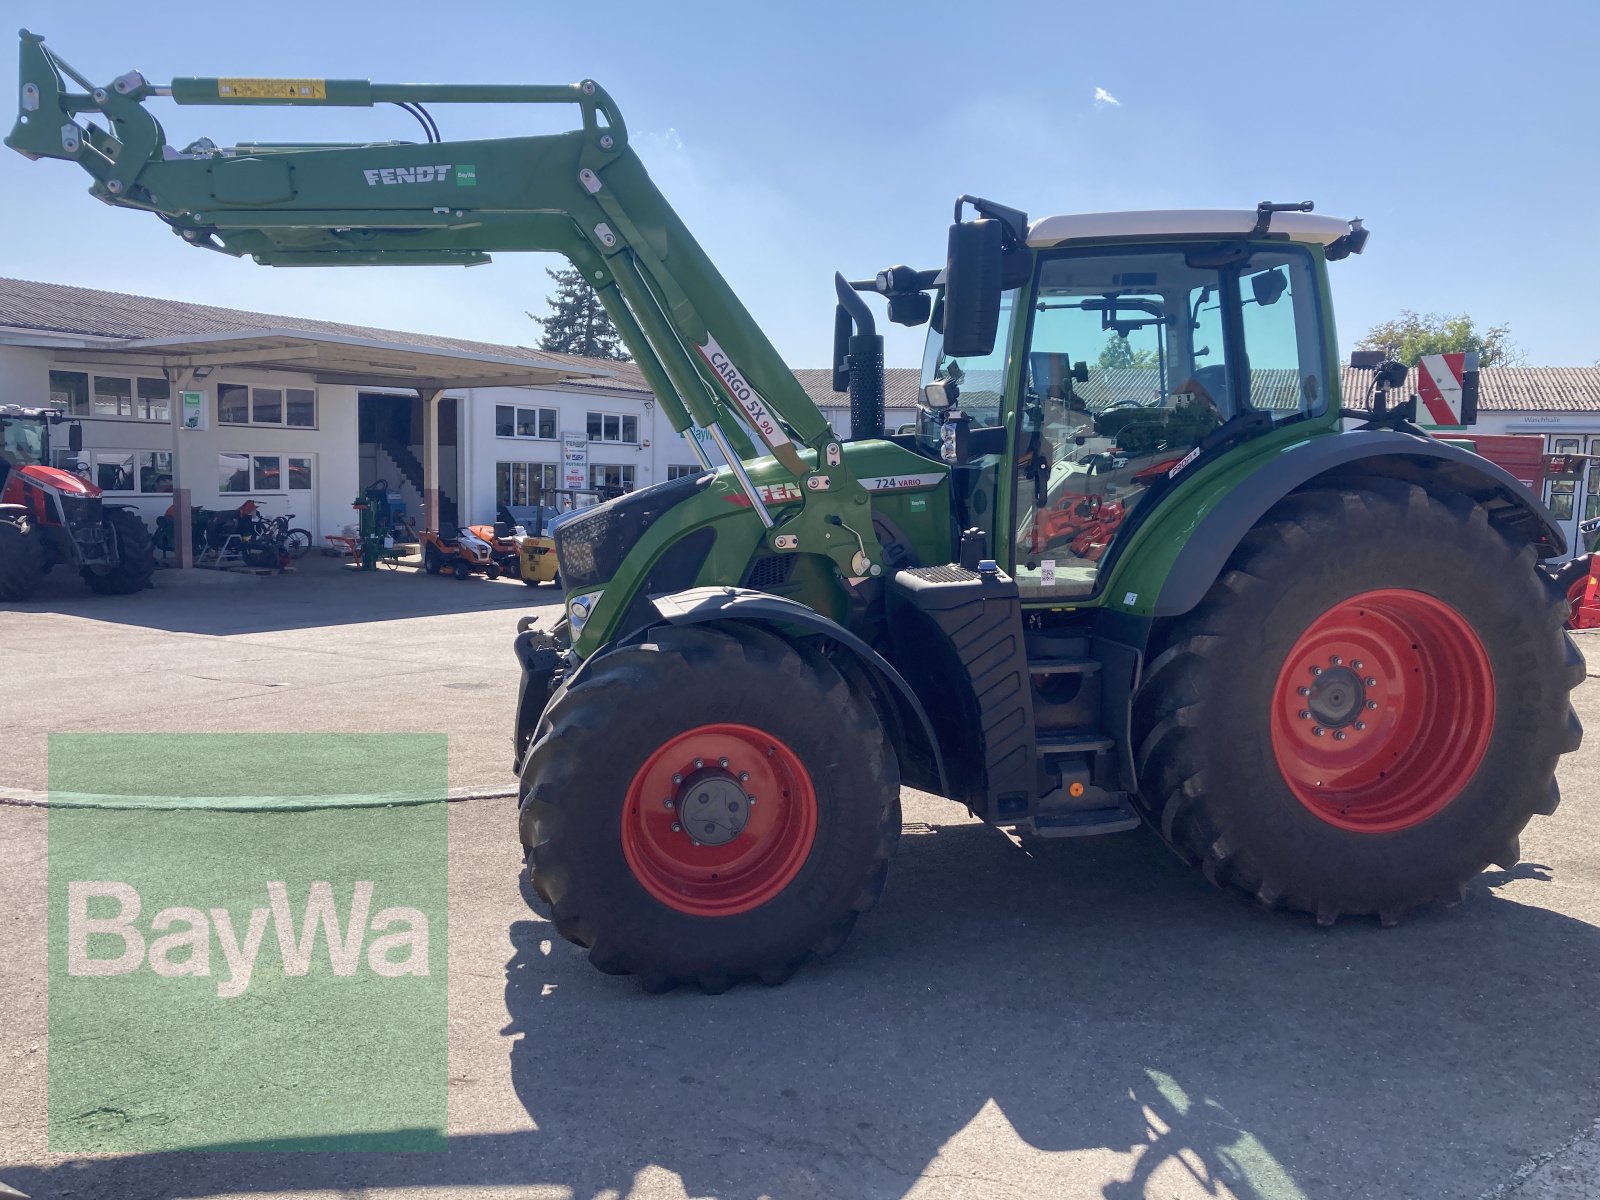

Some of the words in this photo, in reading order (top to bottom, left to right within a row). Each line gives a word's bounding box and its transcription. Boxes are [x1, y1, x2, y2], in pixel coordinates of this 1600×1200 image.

[363, 164, 452, 186] FENDT
[711, 352, 750, 401] CARGO
[746, 400, 766, 421] 5X
[760, 420, 774, 435] 90
[1172, 453, 1194, 475] PROFI
[755, 482, 802, 502] FEN
[875, 477, 896, 489] 724
[898, 478, 921, 487] VARIO
